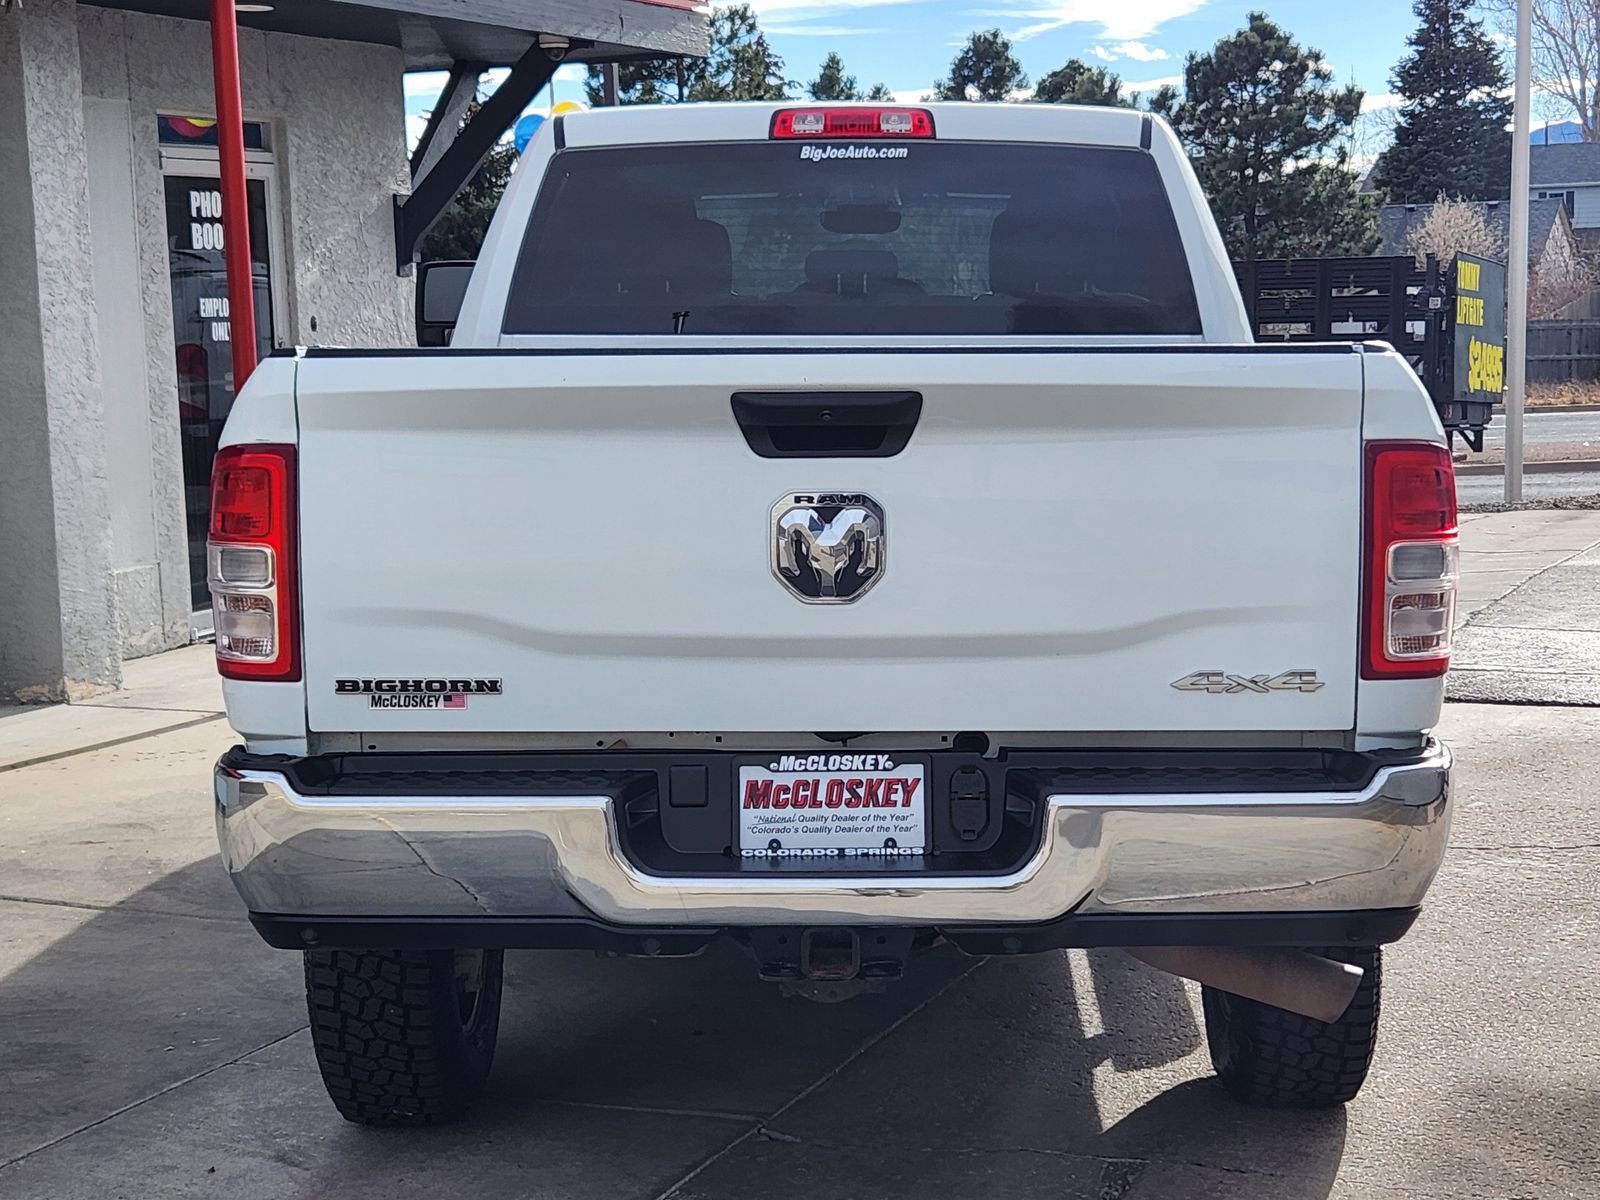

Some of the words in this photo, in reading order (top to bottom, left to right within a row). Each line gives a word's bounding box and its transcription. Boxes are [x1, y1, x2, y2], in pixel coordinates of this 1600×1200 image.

[800, 145, 908, 162] BigJoeAuto.com
[190, 191, 222, 218] PHO
[191, 223, 225, 250] BOO
[200, 298, 230, 318] EMPLO
[793, 494, 863, 505] RAM
[335, 678, 502, 694] BIGHORN
[370, 694, 441, 708] McCLOSKEY
[779, 754, 890, 772] McCLOSKEY
[743, 778, 921, 809] McCLOSKEY
[798, 814, 829, 825] Quality
[830, 814, 860, 823] Dealer
[861, 813, 871, 822] of
[873, 813, 887, 822] the
[801, 825, 832, 836] Quality
[834, 825, 863, 833] Dealer
[865, 825, 875, 833] of
[876, 824, 891, 833] the
[741, 848, 839, 857] COLORADO
[844, 847, 924, 856] SPRINGS
